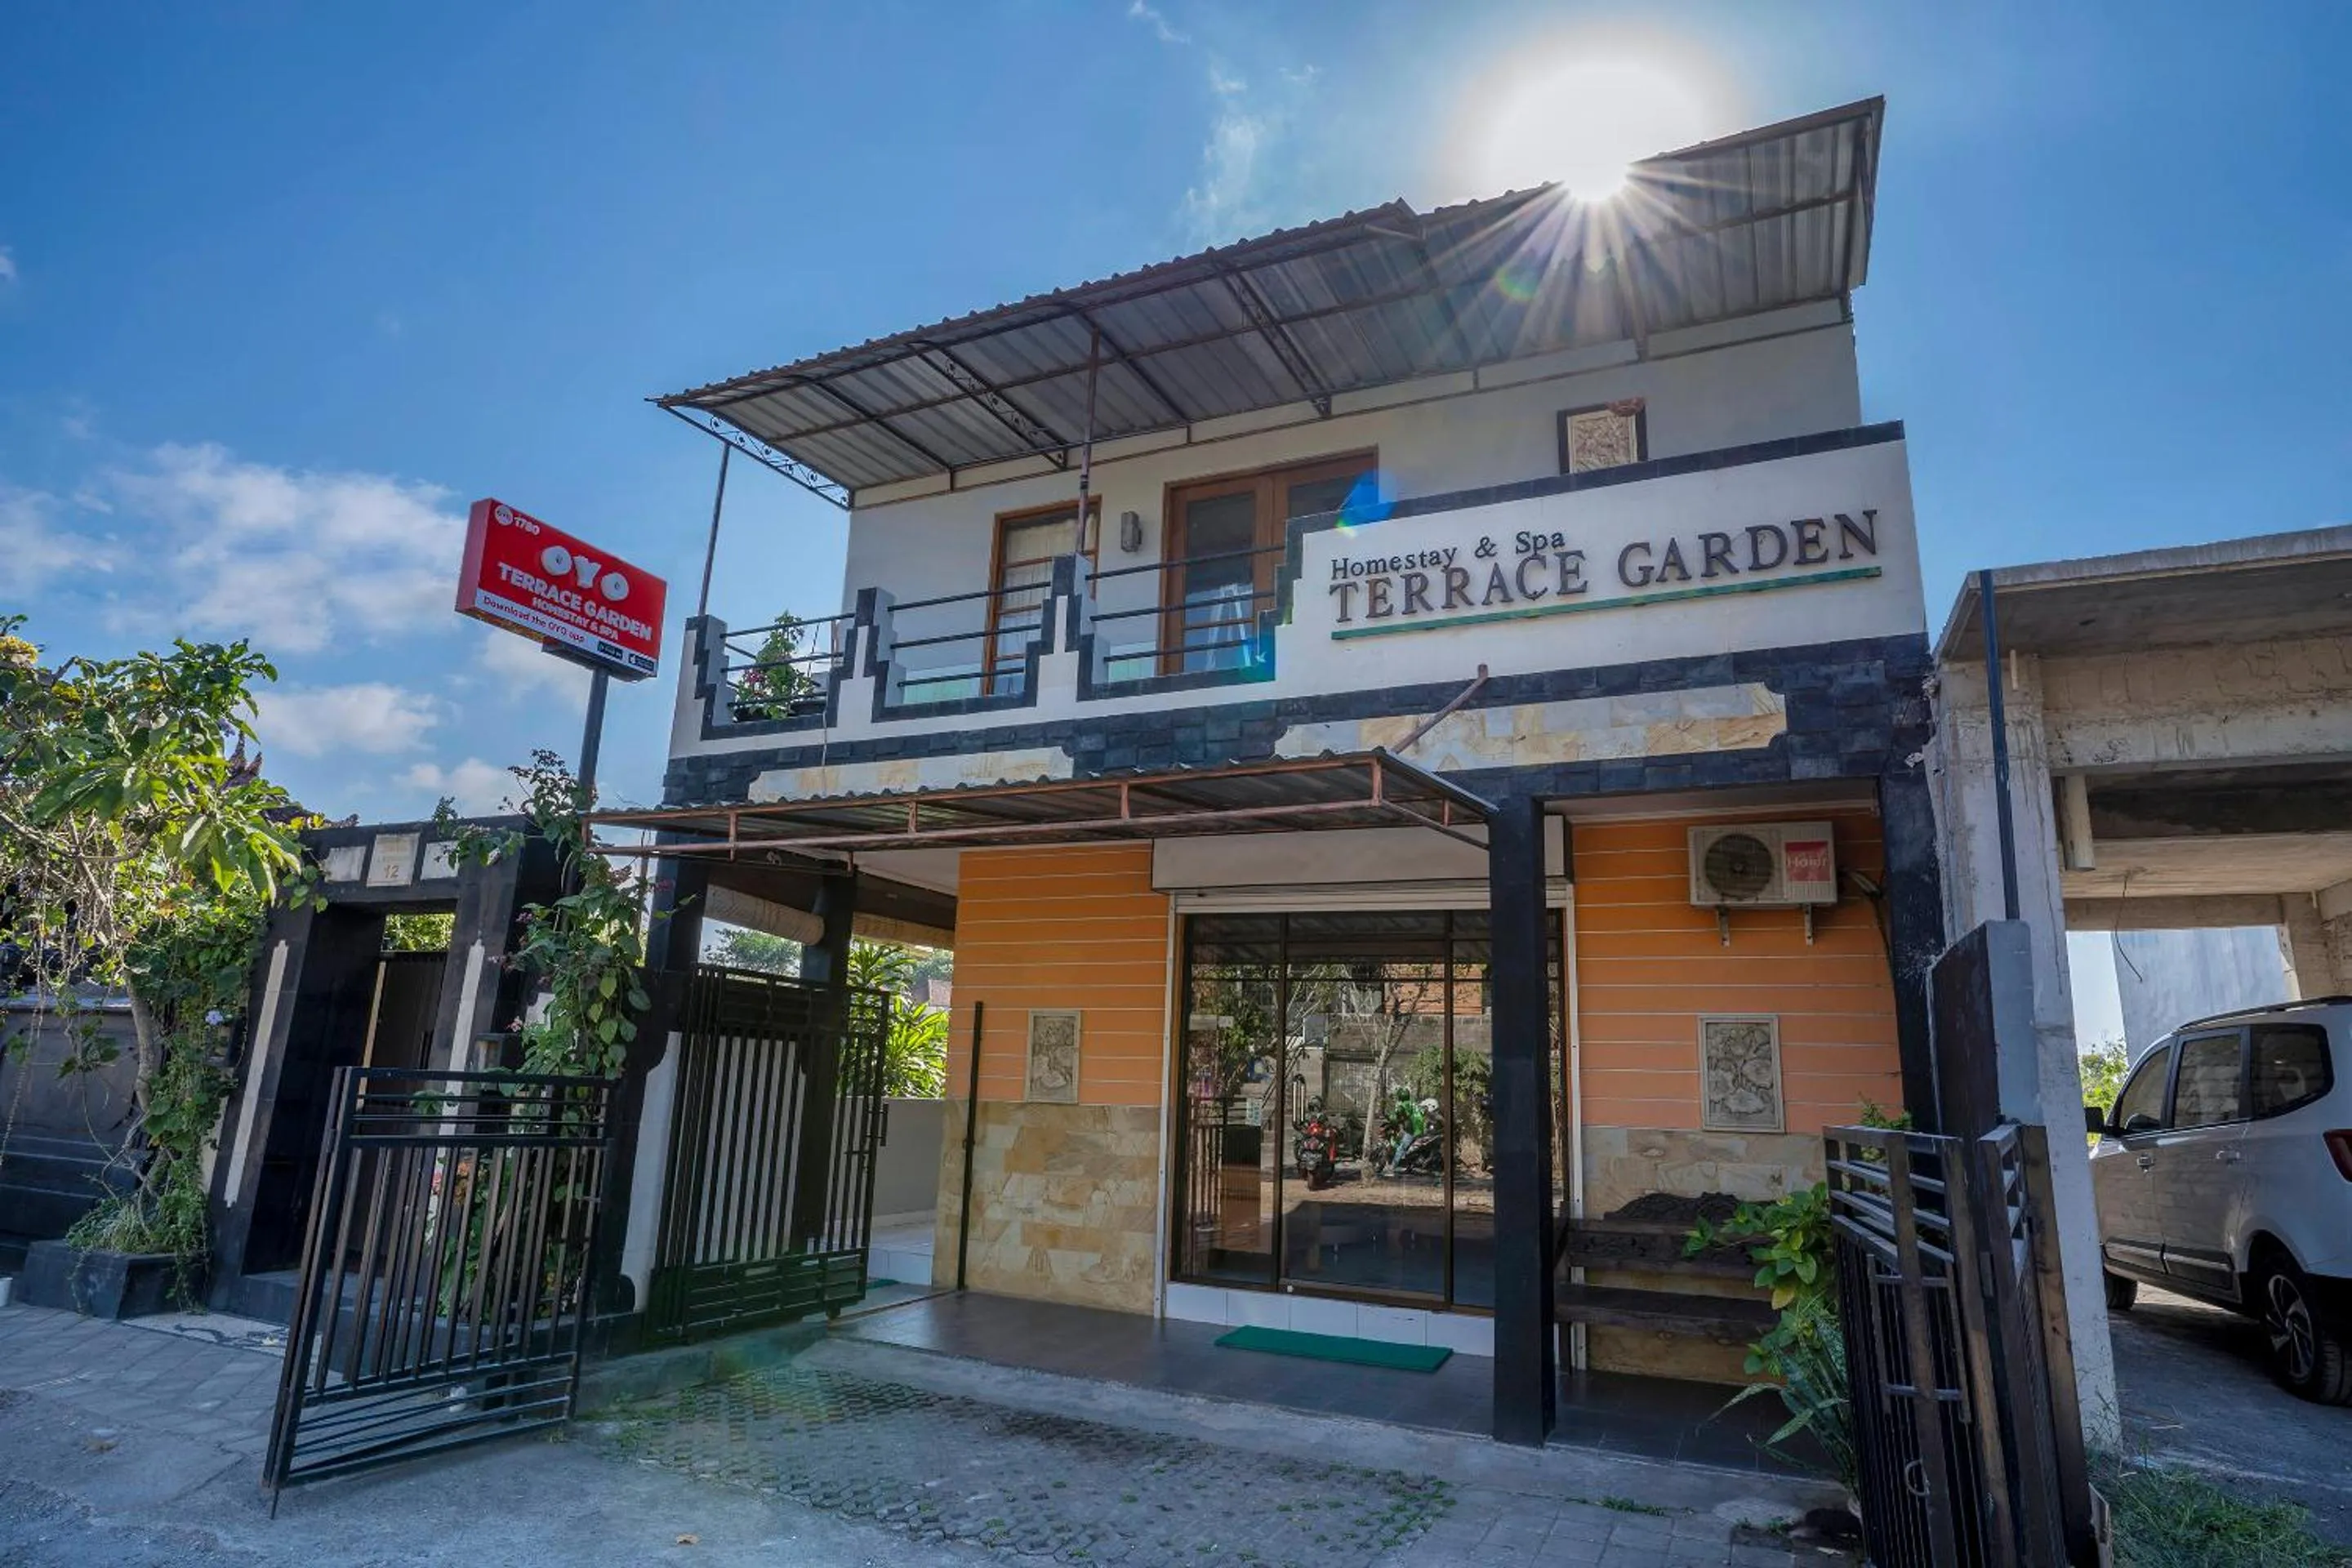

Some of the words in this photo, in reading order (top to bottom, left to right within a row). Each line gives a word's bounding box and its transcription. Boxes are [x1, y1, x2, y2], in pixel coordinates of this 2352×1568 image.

[541, 546, 629, 601] OYO
[1329, 550, 1588, 623] TERRACE
[1618, 509, 1879, 590] GARDEN
[1330, 546, 1458, 581] Homestay
[1474, 536, 1498, 558] &
[1515, 529, 1566, 557] Spa
[483, 595, 530, 621] Download
[532, 616, 546, 628] the
[498, 562, 582, 612] TERRACE
[584, 600, 653, 641] GARDEN
[384, 864, 399, 879] 12
